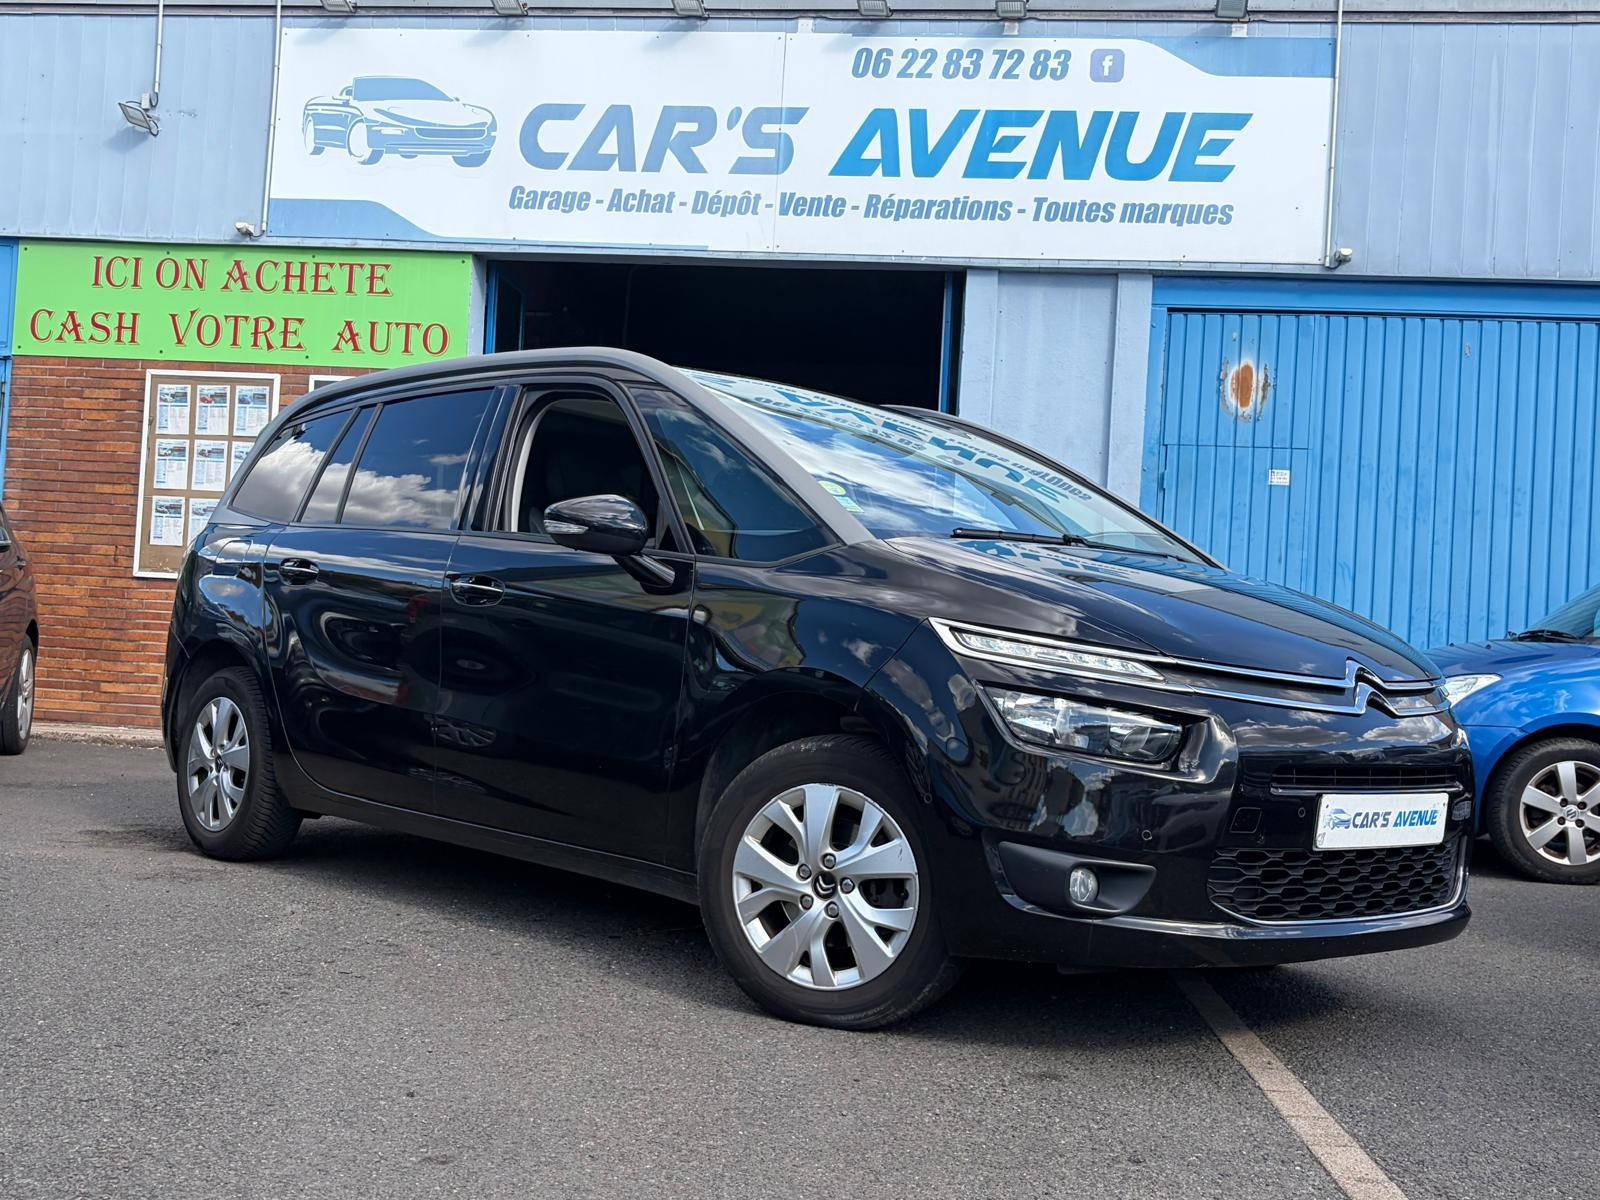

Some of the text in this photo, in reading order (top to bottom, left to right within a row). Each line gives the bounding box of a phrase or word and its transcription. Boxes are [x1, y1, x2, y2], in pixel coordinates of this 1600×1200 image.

[852, 47, 1072, 81] 06 22 83 72 83
[519, 104, 1254, 183] CAR'S AVENUE
[508, 185, 591, 214] Garage
[606, 188, 676, 214] Achat
[691, 190, 762, 218] Dépôt
[778, 191, 847, 218] Vente
[863, 193, 1013, 222] Réparations
[1032, 196, 1117, 224] Toutes
[1118, 202, 1234, 227] marques
[92, 256, 393, 296] ICI ON ACHETE
[30, 308, 450, 356] CASH VOTRE AUTO
[1352, 809, 1439, 829] CAR'S AVENUE
